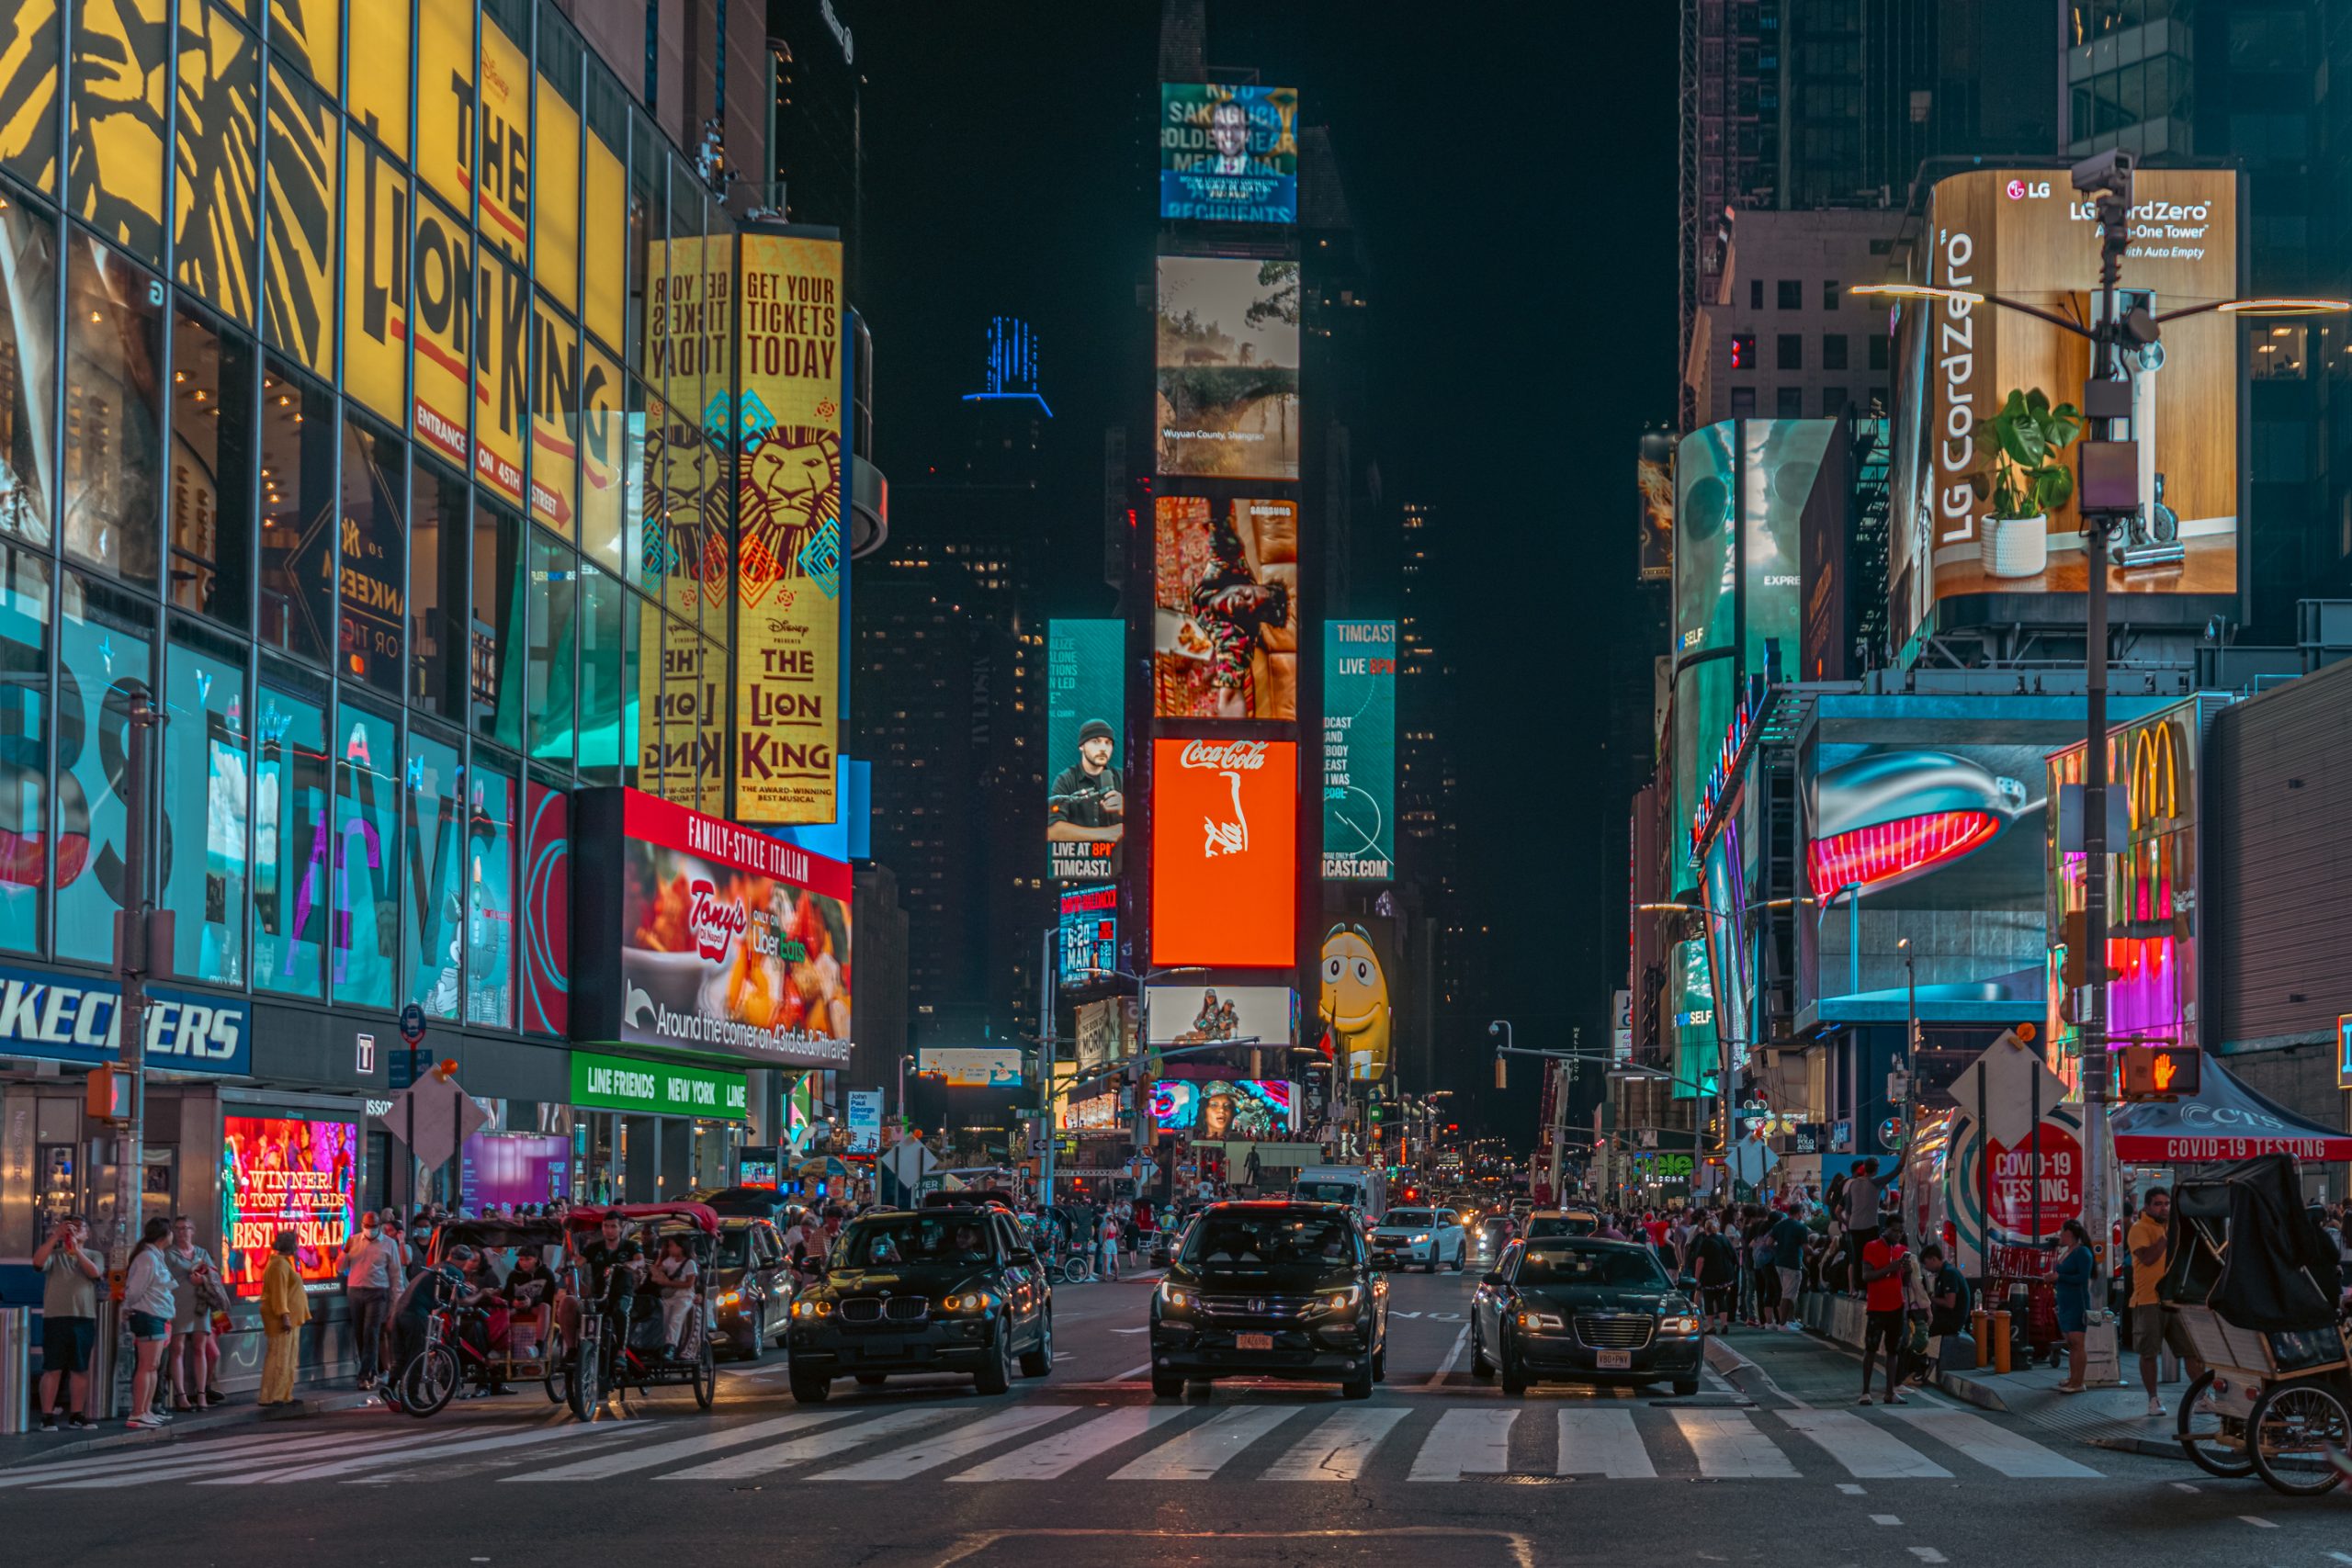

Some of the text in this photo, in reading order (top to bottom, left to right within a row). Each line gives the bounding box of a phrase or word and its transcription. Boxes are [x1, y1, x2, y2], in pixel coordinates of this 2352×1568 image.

[451, 68, 526, 222] THE
[2029, 184, 2050, 198] LG
[2071, 202, 2096, 220] LG
[363, 107, 491, 376] LION
[2144, 246, 2169, 257] Auto
[2171, 246, 2205, 260] Empty
[747, 272, 834, 305] GET YOUR
[747, 300, 835, 338] TICKETS
[500, 237, 608, 468] KING
[747, 333, 836, 380] TODAY
[417, 404, 466, 455] ENTRANCE
[1163, 428, 1195, 440] Wuyuan
[1227, 430, 1265, 441] Shangrao
[479, 446, 521, 492] ON 45TH
[530, 484, 558, 516] STREET
[1250, 506, 1291, 516] SAMSUNG
[1942, 483, 1973, 543] LG
[765, 617, 809, 637] Disney
[760, 649, 814, 673] THE
[1339, 659, 1366, 675] LIVE
[1057, 678, 1075, 689] LED
[750, 683, 822, 727] LION
[741, 732, 831, 780] KING
[759, 785, 831, 795] AWARD-WINNING
[1331, 773, 1351, 785] WAS
[757, 794, 815, 803] BEST MUSICAL
[689, 816, 809, 883] FAMILY-STYLE ITALIAN
[1052, 841, 1075, 857] LIVE
[1077, 841, 1091, 857] AT
[690, 878, 747, 964] Tony's
[753, 909, 769, 925] ONLY
[752, 928, 806, 963] Uber Eats
[1068, 923, 1091, 948] 6:20
[1067, 947, 1091, 970] MAN
[656, 1002, 701, 1041] Around
[703, 1011, 721, 1043] the
[723, 1021, 758, 1048] corner
[759, 1027, 772, 1049] on
[773, 1023, 796, 1053] 43rd
[808, 1031, 816, 1055] &
[816, 1030, 831, 1058] 7th
[588, 1066, 745, 1108] LINE FRIENDS NEW YORK LINE
[2168, 1138, 2325, 1157] COVID-19 TESTING
[248, 1169, 334, 1190] WINNER!
[233, 1193, 346, 1207] 10 TONY AWARDS
[232, 1222, 274, 1249] BEST
